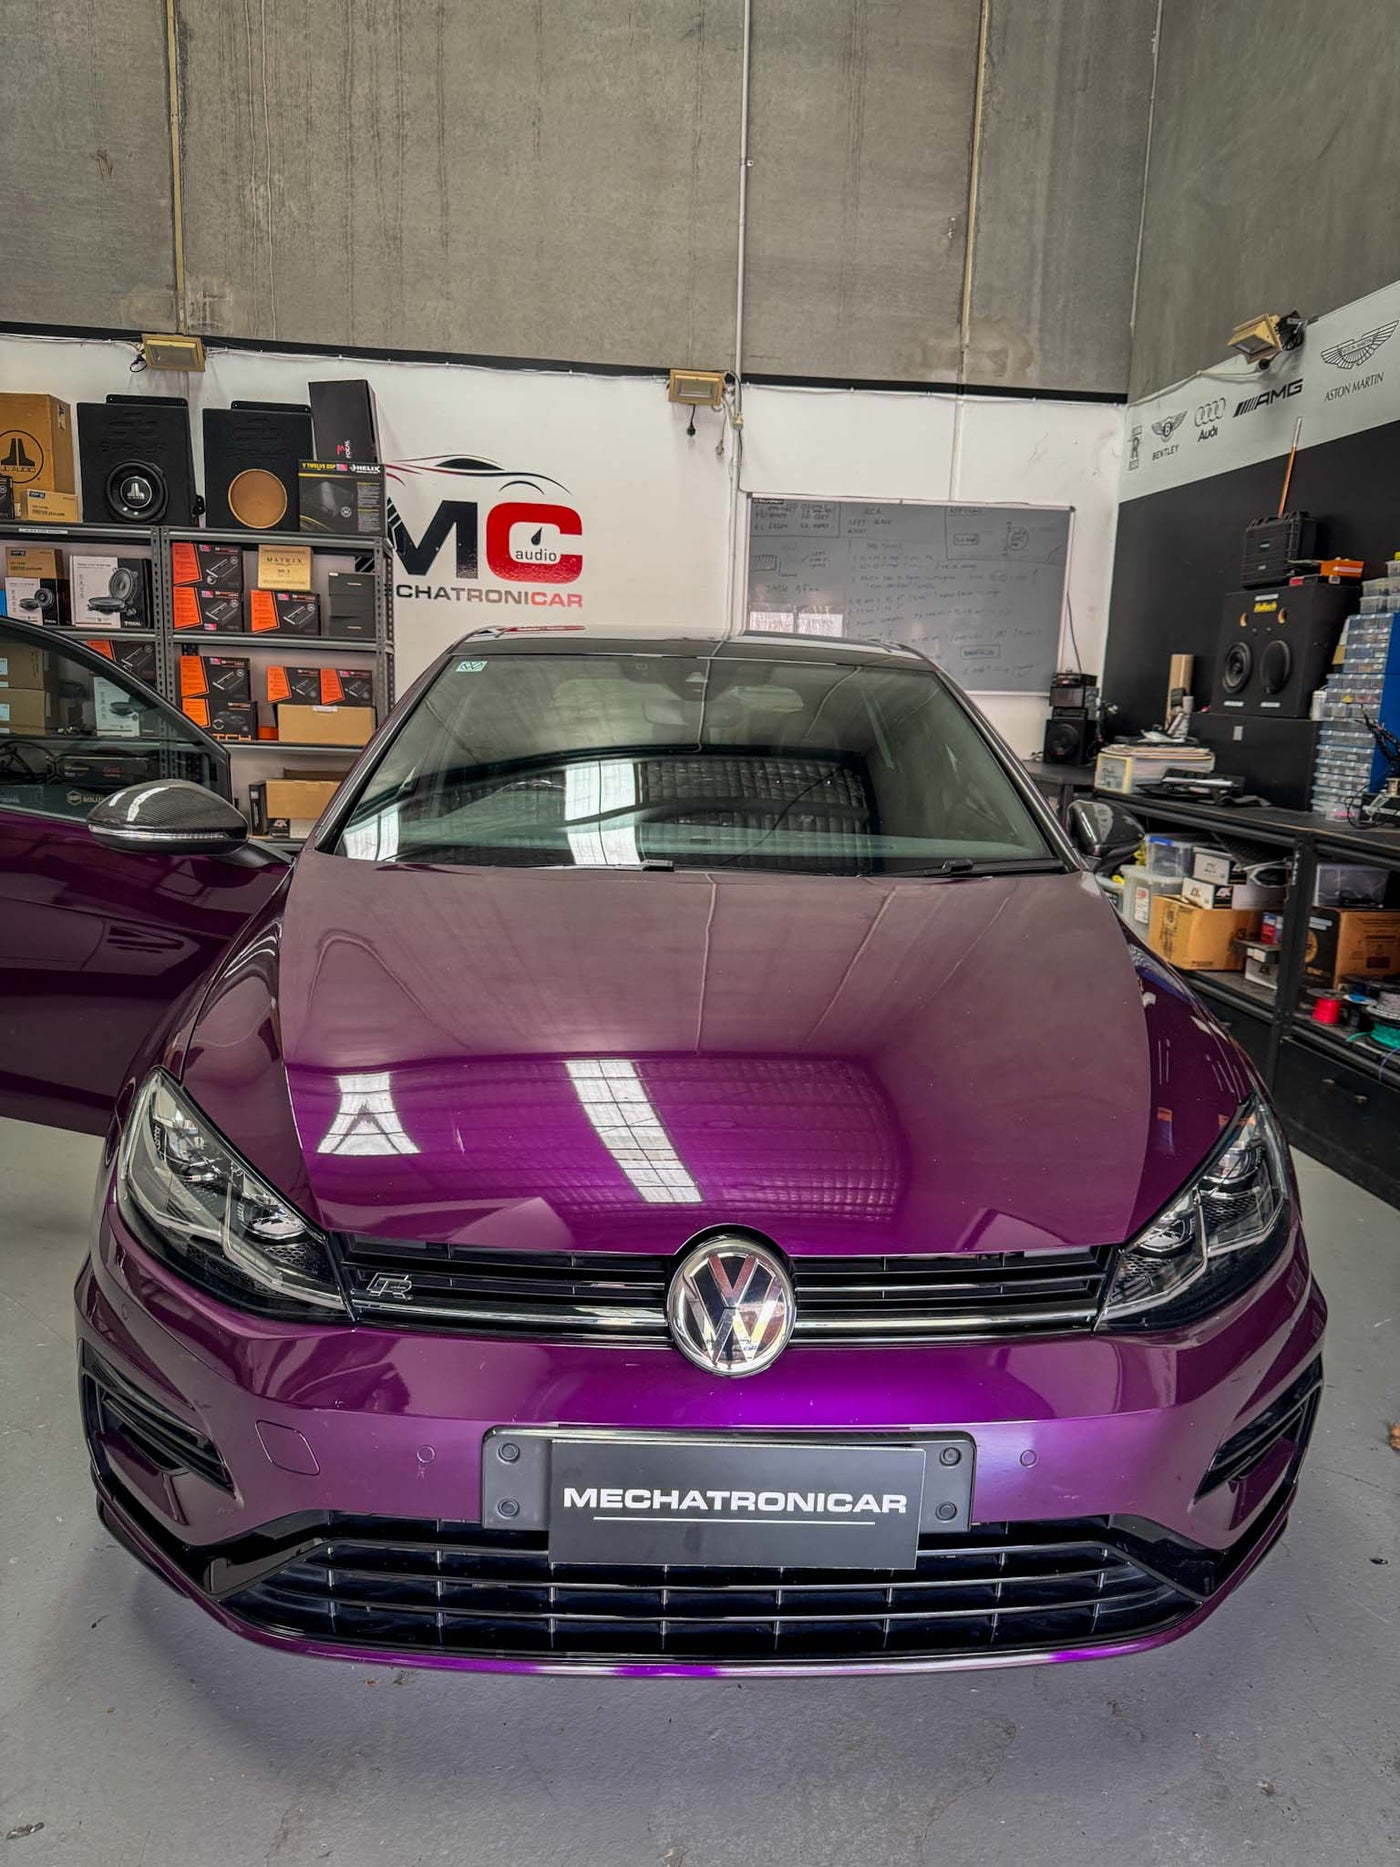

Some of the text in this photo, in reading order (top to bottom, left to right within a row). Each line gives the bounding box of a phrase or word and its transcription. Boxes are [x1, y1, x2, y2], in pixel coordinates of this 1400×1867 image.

[1253, 378, 1304, 410] AMG
[1324, 372, 1385, 402] ASTON MARTIN
[1197, 425, 1218, 442] Audi
[1151, 444, 1179, 461] BENTLEY
[356, 465, 381, 473] HELIX
[515, 548, 558, 562] audio
[385, 583, 583, 608] CHATRONICAR
[213, 733, 251, 741] TCH
[563, 1487, 907, 1514] MECHATRONICAR
